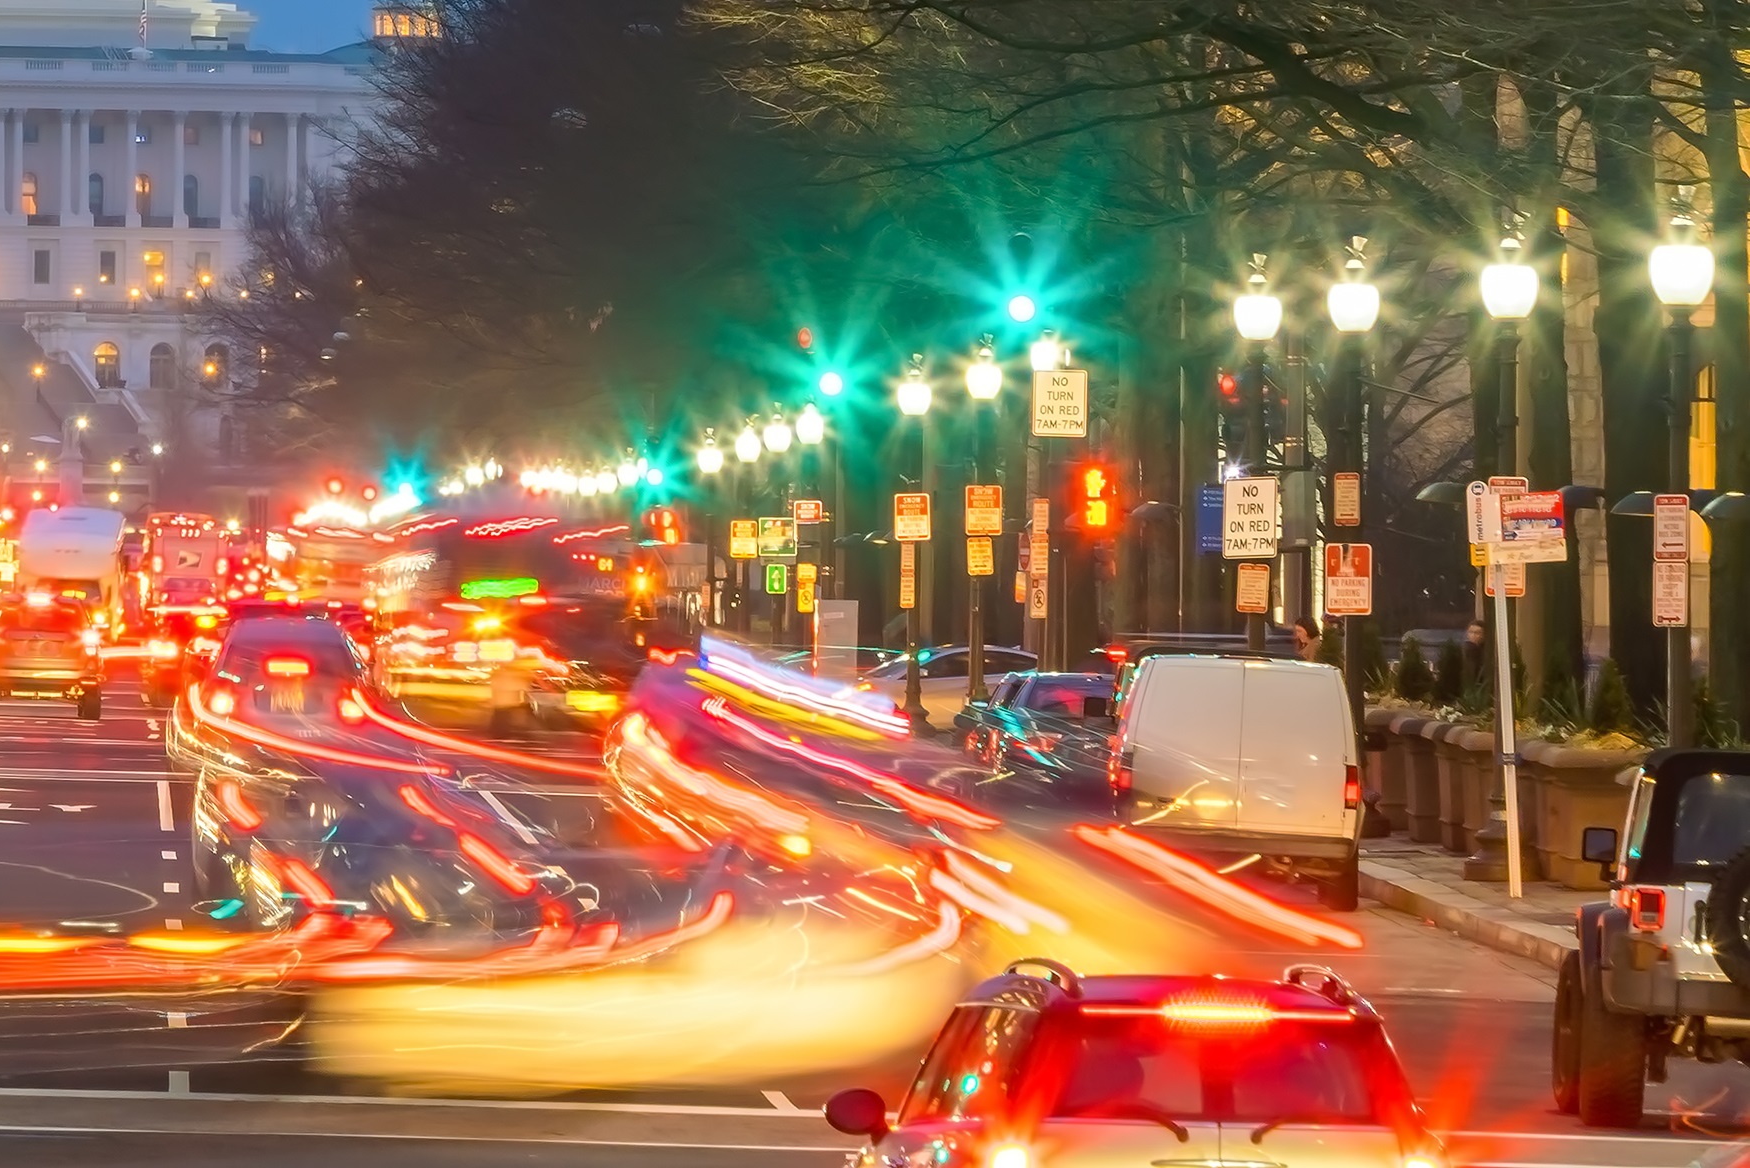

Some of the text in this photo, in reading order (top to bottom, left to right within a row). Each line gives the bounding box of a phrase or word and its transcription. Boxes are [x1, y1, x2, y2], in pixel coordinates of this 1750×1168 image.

[1052, 377, 1068, 386] NO
[1047, 391, 1074, 401] TURN
[1040, 405, 1080, 415] ON RED
[1036, 419, 1084, 429] 7AM-7PM
[1243, 485, 1259, 497] NO
[1237, 503, 1264, 515] TURN
[1474, 497, 1484, 541] metrobus
[1230, 520, 1270, 533] ON RED
[1226, 538, 1274, 550] 7AM-7PM
